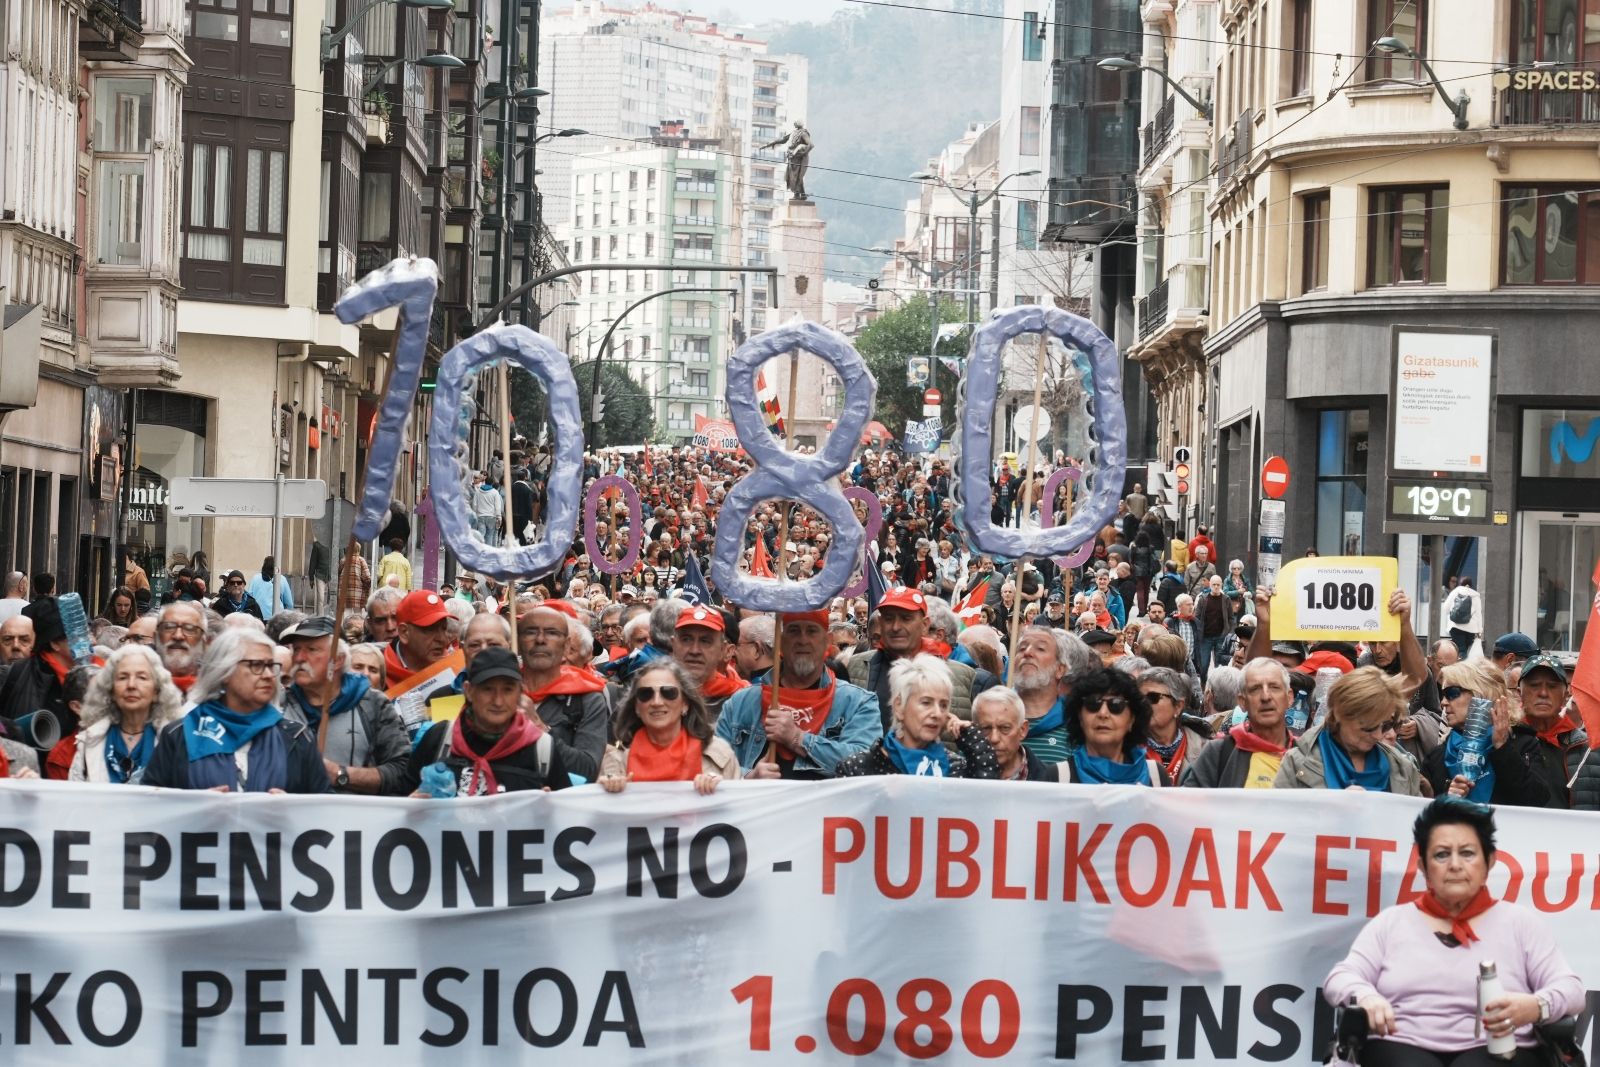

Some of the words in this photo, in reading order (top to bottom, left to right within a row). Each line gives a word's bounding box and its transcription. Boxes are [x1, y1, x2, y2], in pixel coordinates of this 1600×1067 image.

[1403, 354, 1479, 368] Gizatasunik
[1303, 582, 1374, 611] 1.080
[0, 827, 90, 909] DE
[123, 826, 597, 912] PENSIONES
[626, 823, 747, 899] NO
[823, 817, 1284, 912] PUBLIKOAK
[0, 970, 142, 1047] KO
[182, 967, 646, 1048] PENTSIOA
[732, 975, 1020, 1058] 1.080
